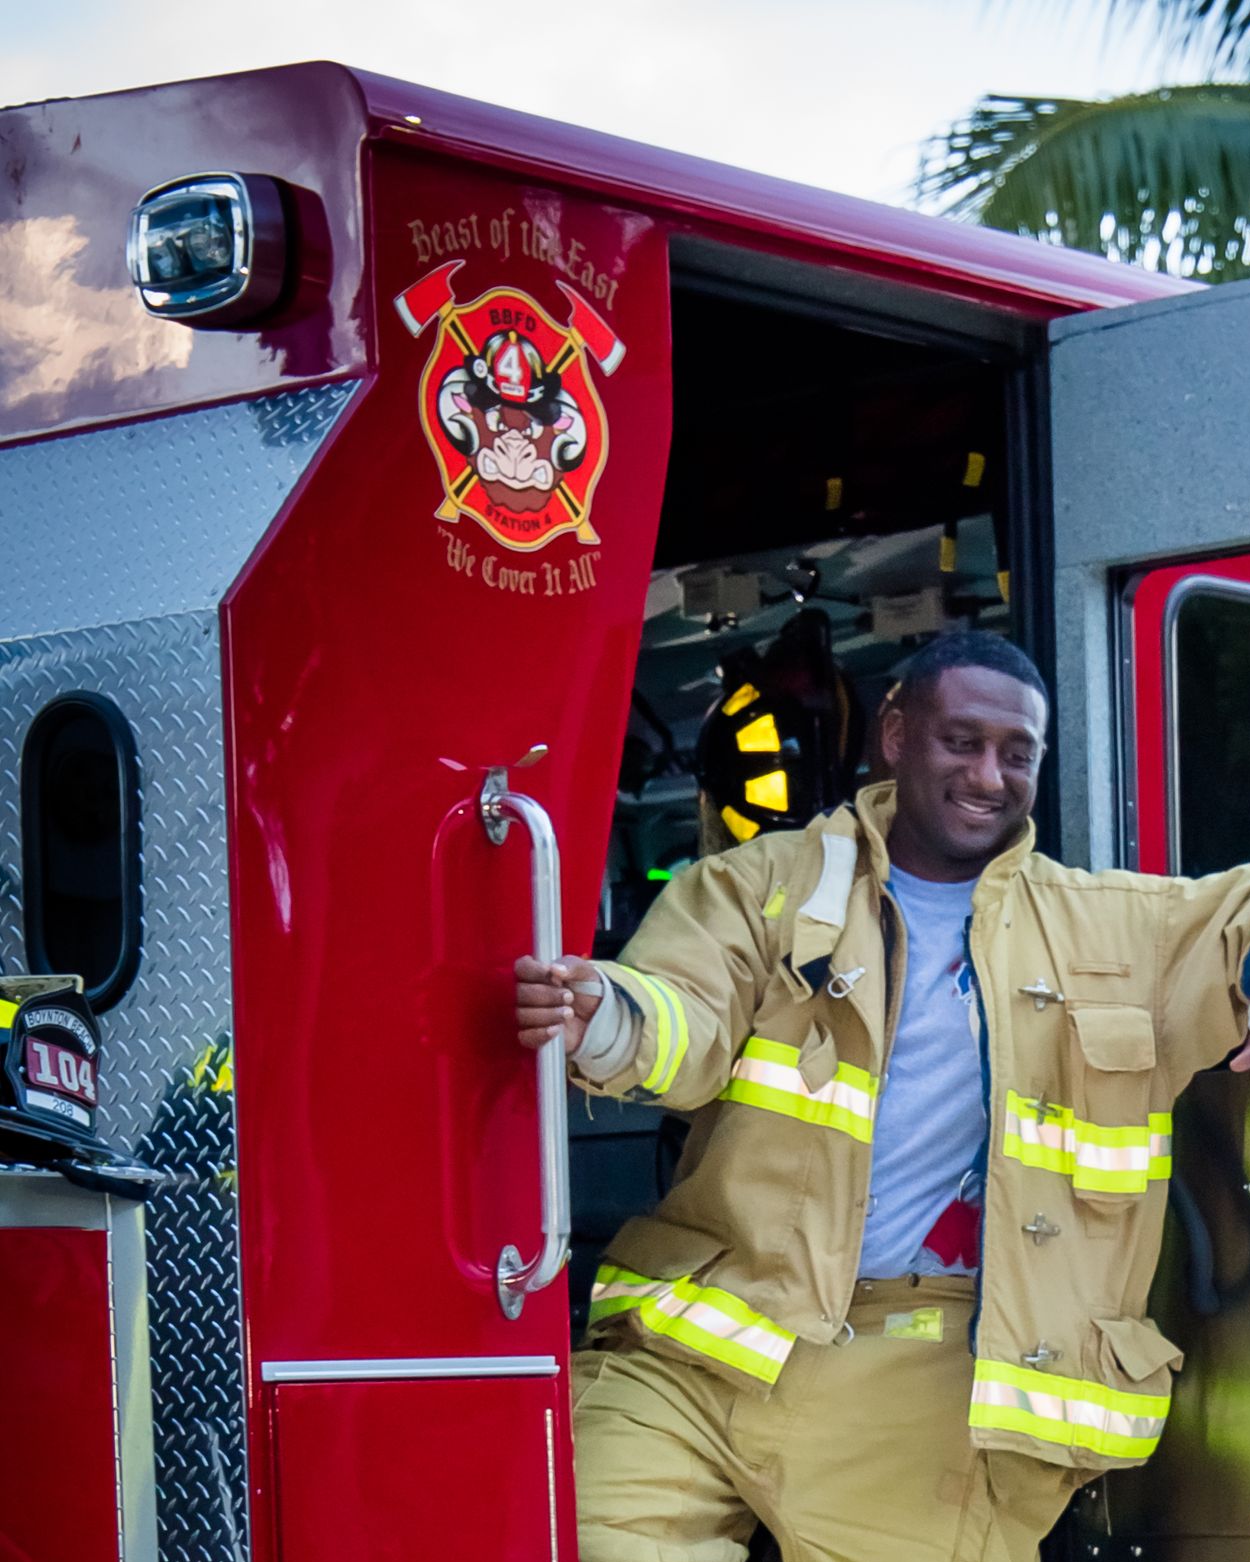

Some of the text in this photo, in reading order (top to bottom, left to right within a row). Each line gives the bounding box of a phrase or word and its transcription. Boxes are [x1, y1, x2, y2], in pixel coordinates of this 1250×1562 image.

[407, 208, 619, 311] Beast of the East
[489, 308, 537, 333] BBFD
[498, 344, 523, 384] 4
[484, 503, 541, 532] STATION
[481, 555, 537, 595] Cover
[540, 561, 563, 597] It
[28, 1009, 94, 1051] BOYNTON BEACH
[32, 1042, 96, 1101] 104
[53, 1099, 73, 1117] 208
